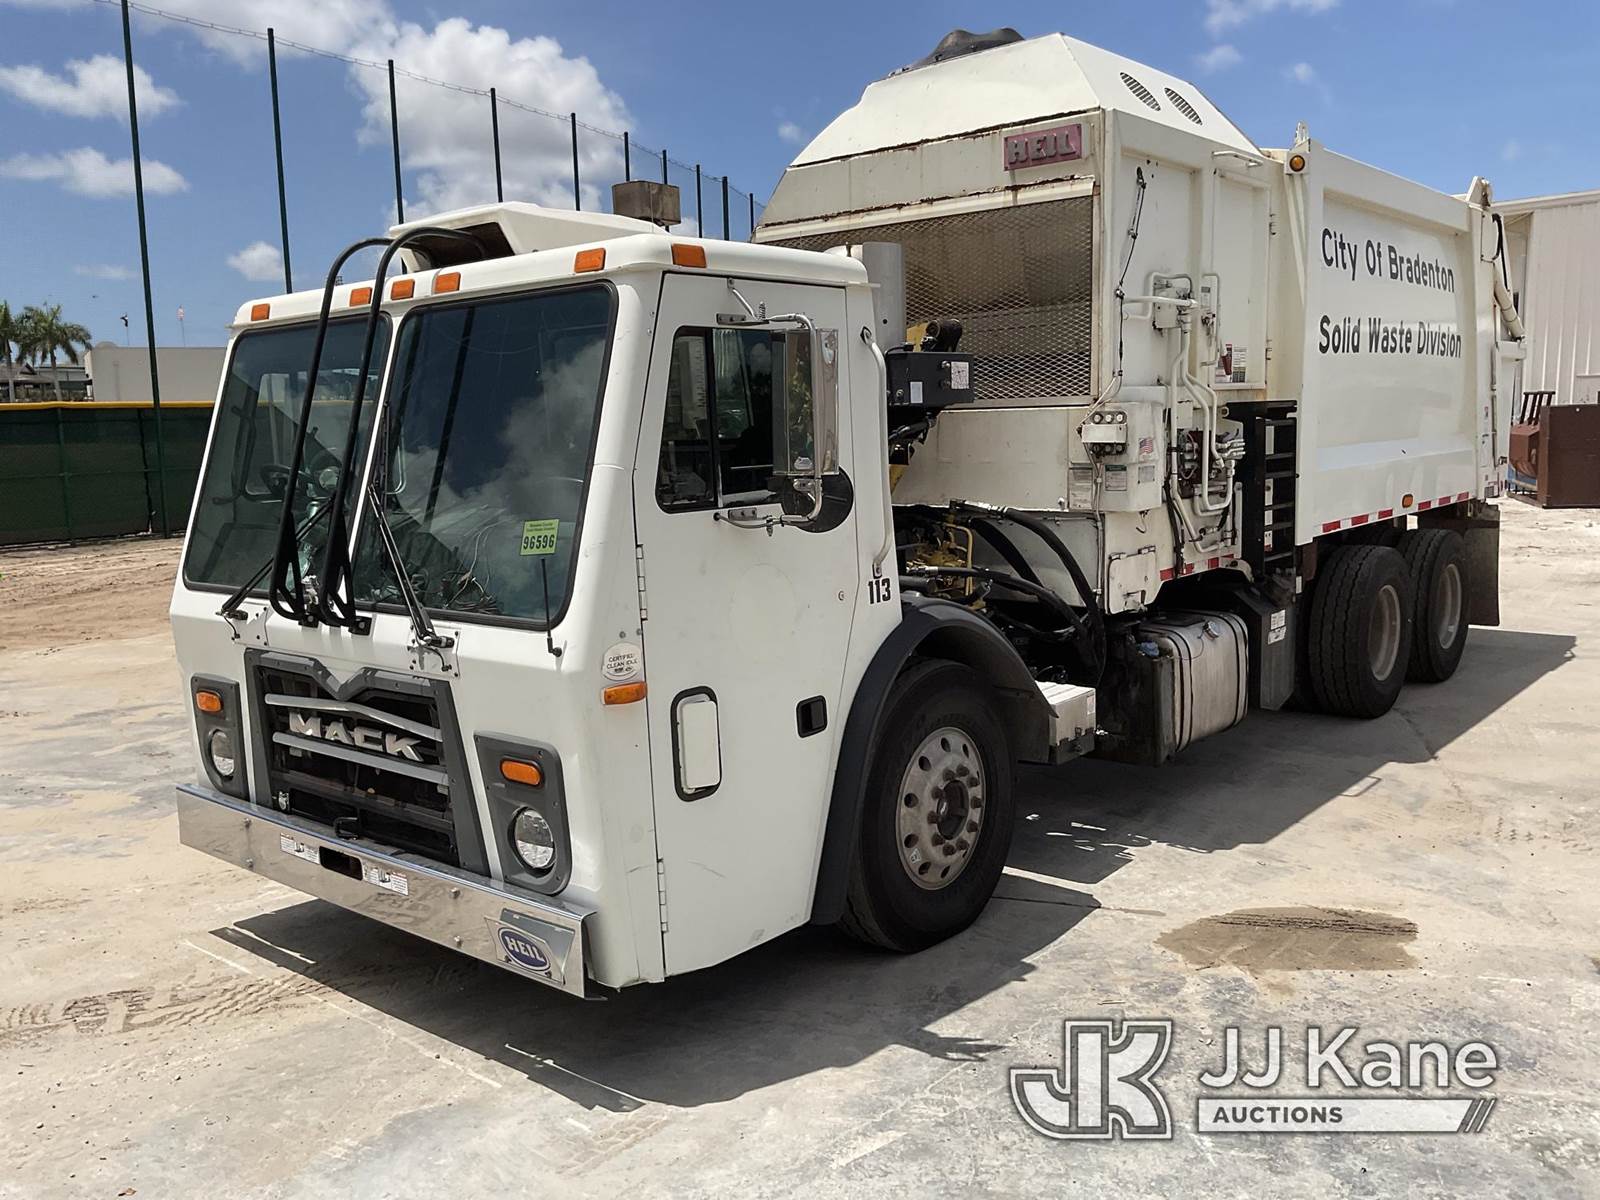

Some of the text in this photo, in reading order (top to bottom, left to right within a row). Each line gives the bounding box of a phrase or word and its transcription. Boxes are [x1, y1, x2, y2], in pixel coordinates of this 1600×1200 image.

[1007, 132, 1077, 165] HEIL
[1322, 228, 1455, 293] City Of Bradenton
[1319, 315, 1462, 358] Solid Waste Division
[523, 535, 555, 549] 96596
[868, 578, 891, 604] 113
[289, 711, 424, 762] MACK
[504, 935, 547, 963] HEIL
